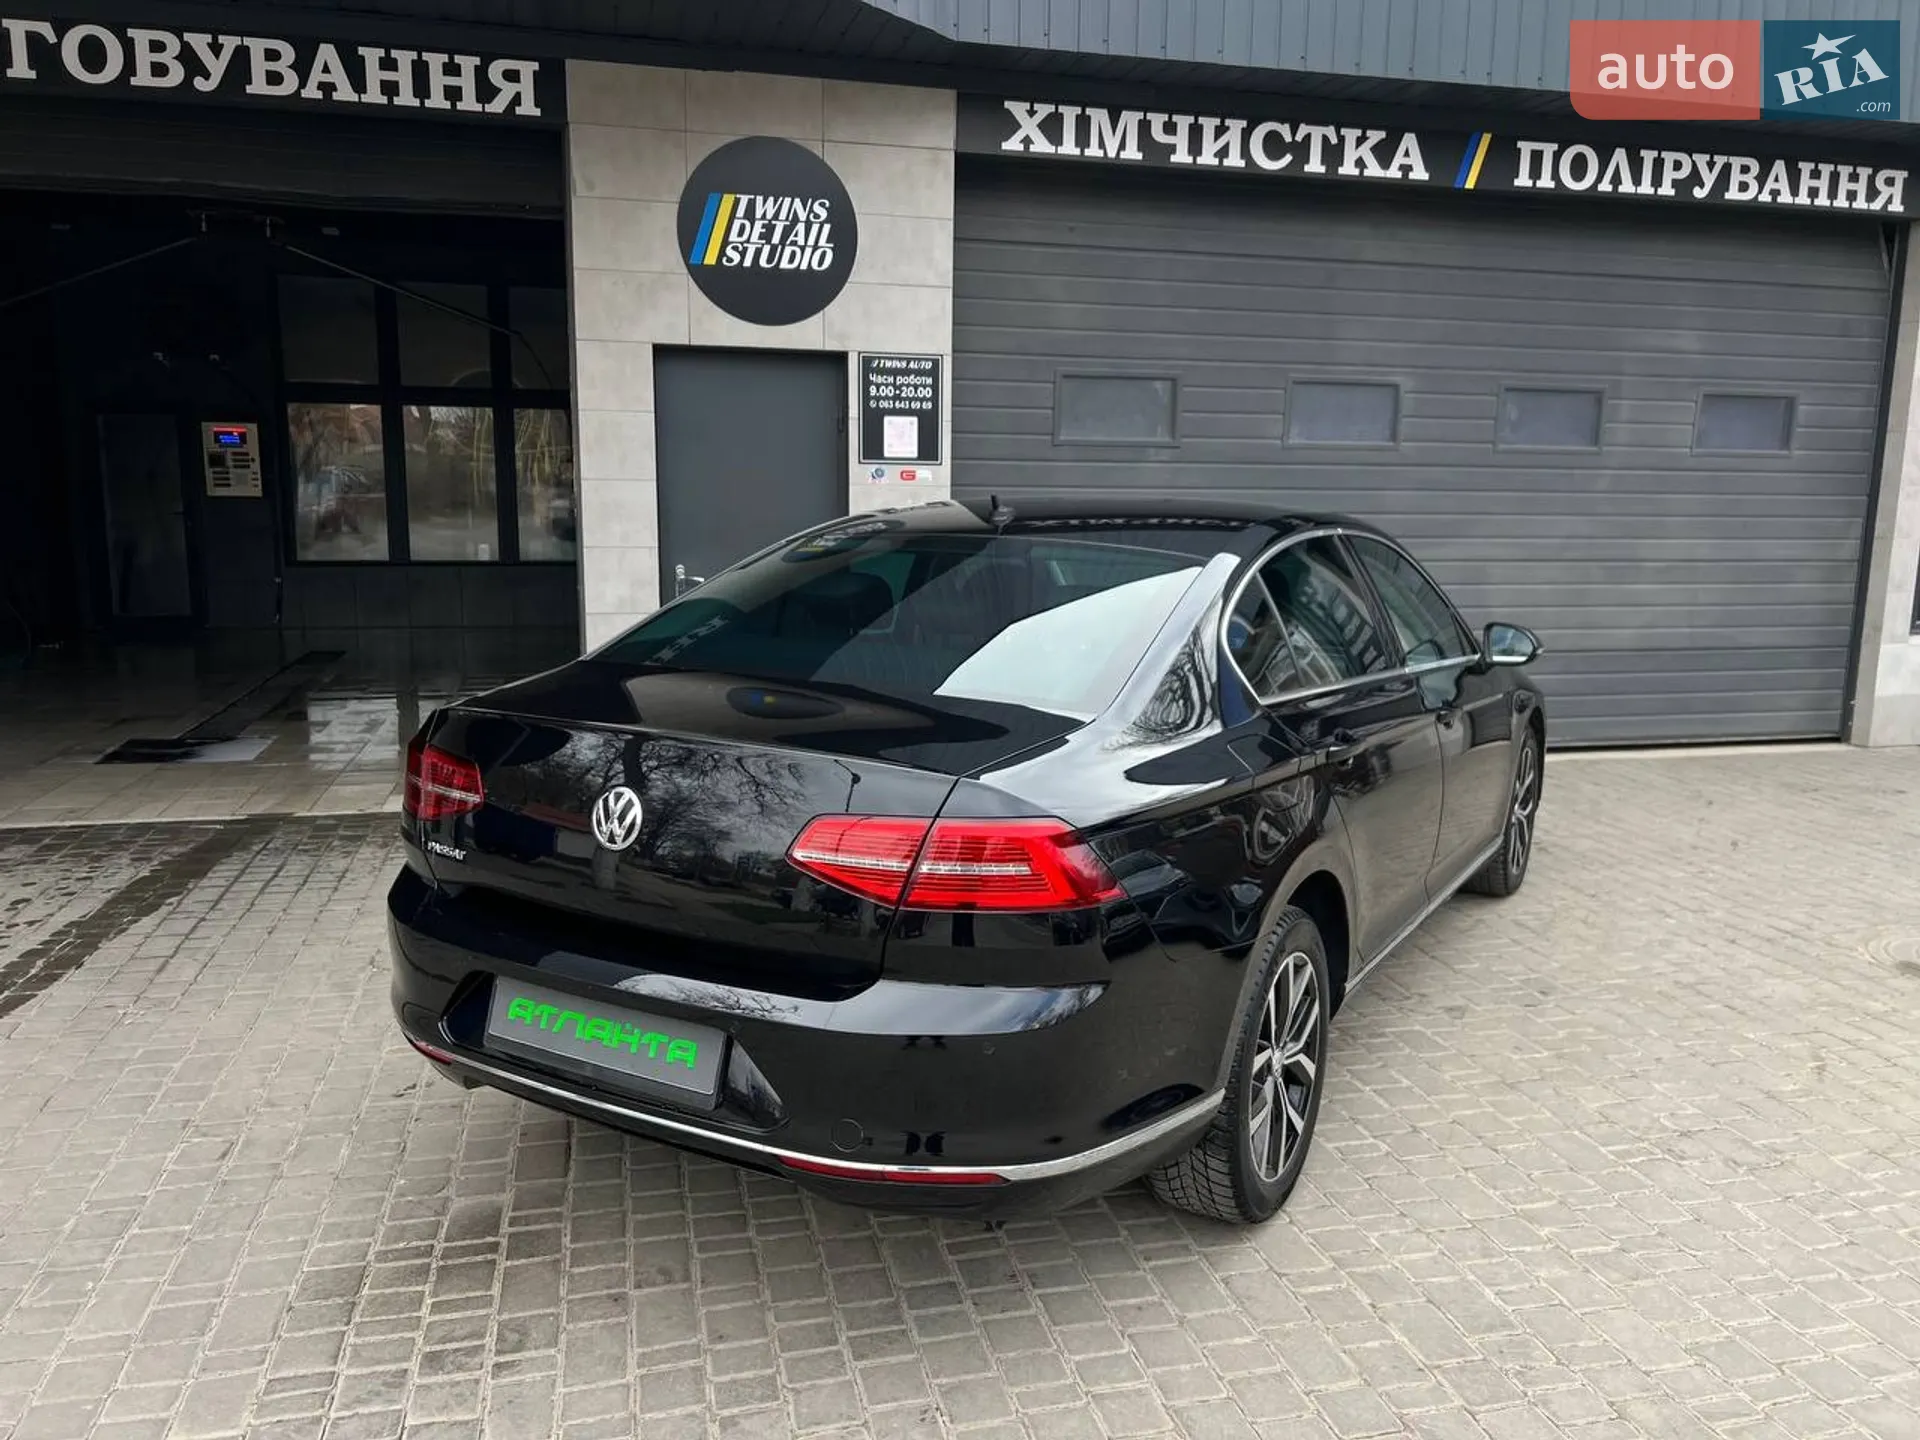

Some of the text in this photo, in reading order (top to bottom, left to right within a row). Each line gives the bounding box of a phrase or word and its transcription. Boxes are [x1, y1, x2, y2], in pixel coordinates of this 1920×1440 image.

[2, 18, 541, 116] ГОВУВАННЯ
[1001, 100, 1909, 213] ХІМЧИСТКА ПОЛІРУВАННЯ
[734, 194, 830, 223] TWINS
[729, 219, 834, 248] DETAIL
[721, 243, 834, 271] STUDIO
[879, 359, 933, 369] TWINS AUTO
[869, 372, 933, 386] Часи роботи
